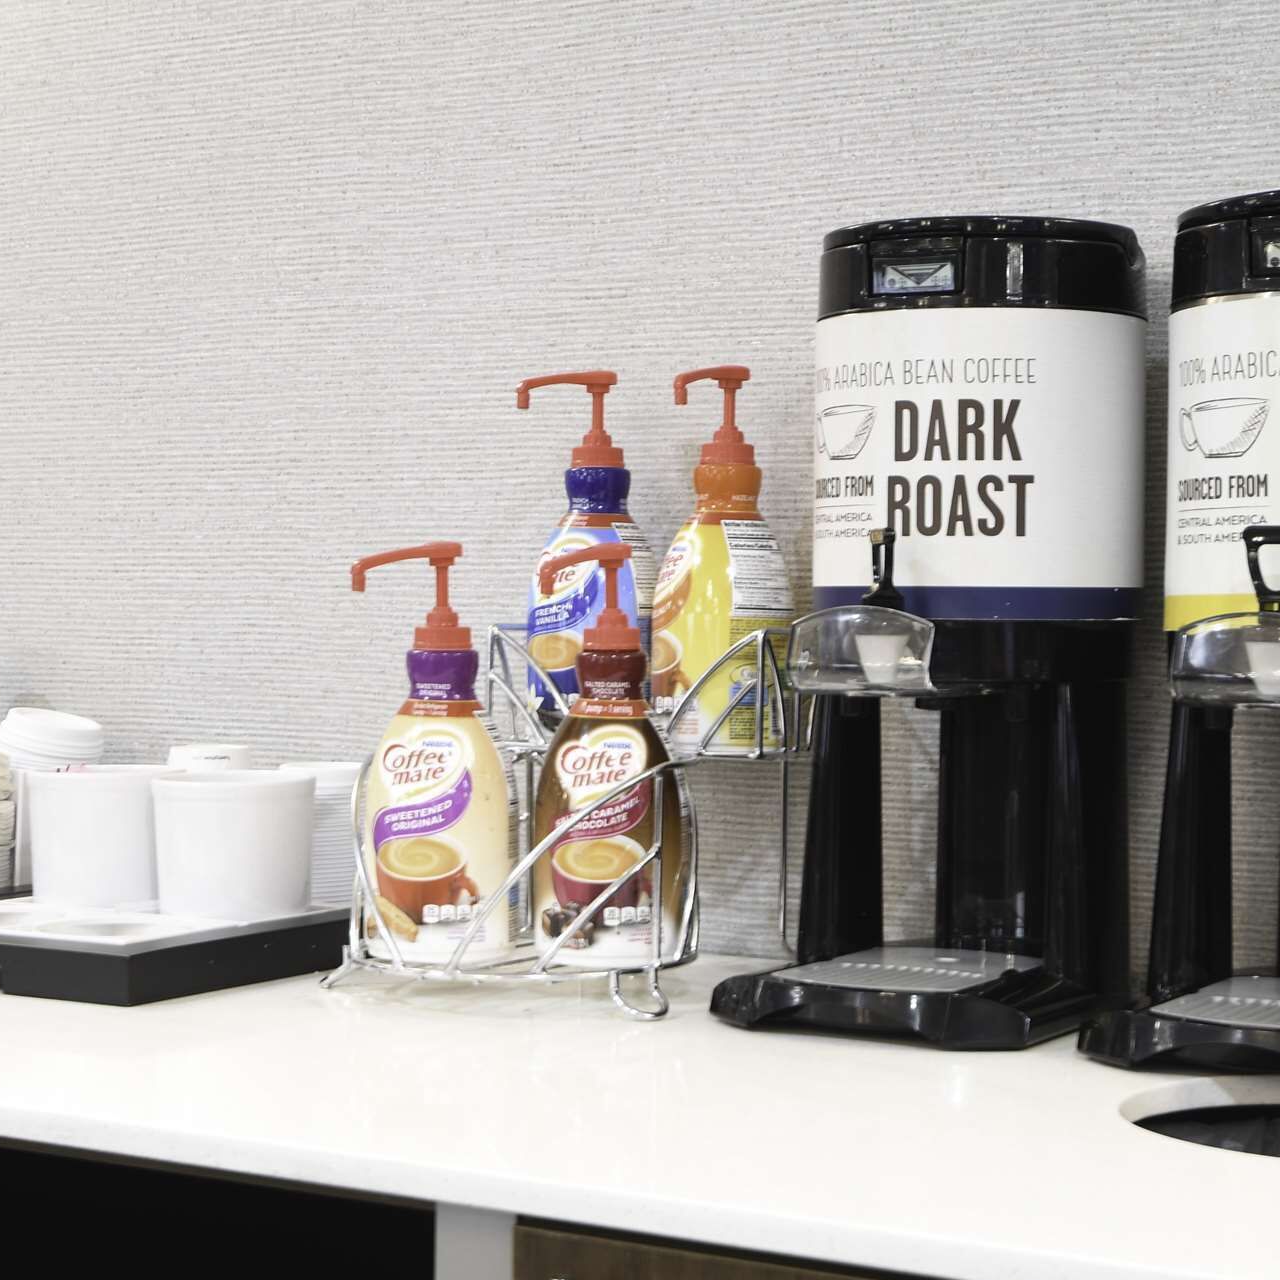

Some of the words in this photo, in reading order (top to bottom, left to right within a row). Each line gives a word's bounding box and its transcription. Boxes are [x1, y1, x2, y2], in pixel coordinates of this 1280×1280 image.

[833, 360, 896, 391] ARABICA
[903, 358, 955, 386] BEAN
[964, 357, 1038, 385] COFFEE
[894, 398, 1023, 462] DARK
[844, 474, 874, 497] FROM
[1178, 477, 1222, 502] SOURCED
[1228, 473, 1269, 499] FROM
[887, 474, 1035, 537] ROAST
[1214, 513, 1268, 527] AMERICA
[535, 602, 573, 617] FRENCH
[535, 611, 571, 626] VANILLA
[561, 743, 633, 775] Coffee
[391, 766, 445, 786] mate
[572, 768, 627, 788] mate
[383, 799, 454, 825] SWEETENED
[390, 814, 447, 832] ORIGINAL
[568, 811, 629, 833] HOCOLATE
